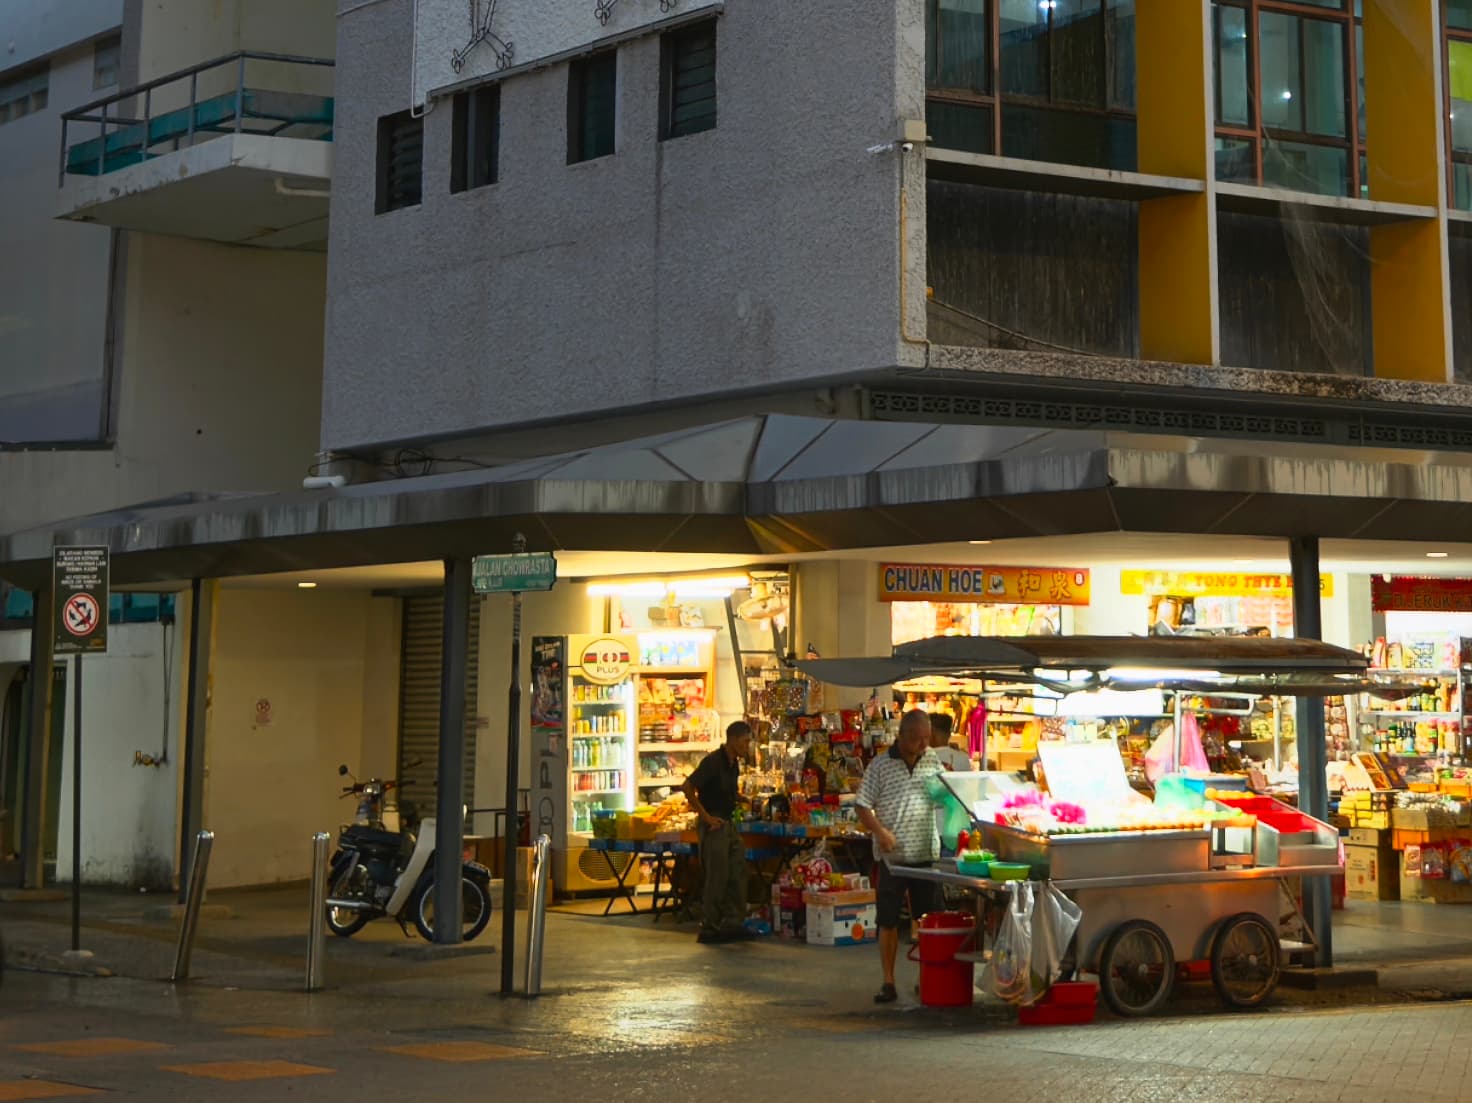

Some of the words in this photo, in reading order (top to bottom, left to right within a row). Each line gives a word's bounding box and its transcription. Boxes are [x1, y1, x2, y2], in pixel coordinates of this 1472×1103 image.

[477, 560, 501, 577] JALAN
[503, 558, 551, 576] CHOWRASTA
[884, 567, 943, 593] CHUAN
[949, 567, 983, 594] HOE
[1193, 574, 1239, 588] TONG
[1243, 575, 1282, 588] THYE
[596, 665, 619, 674] PLUS
